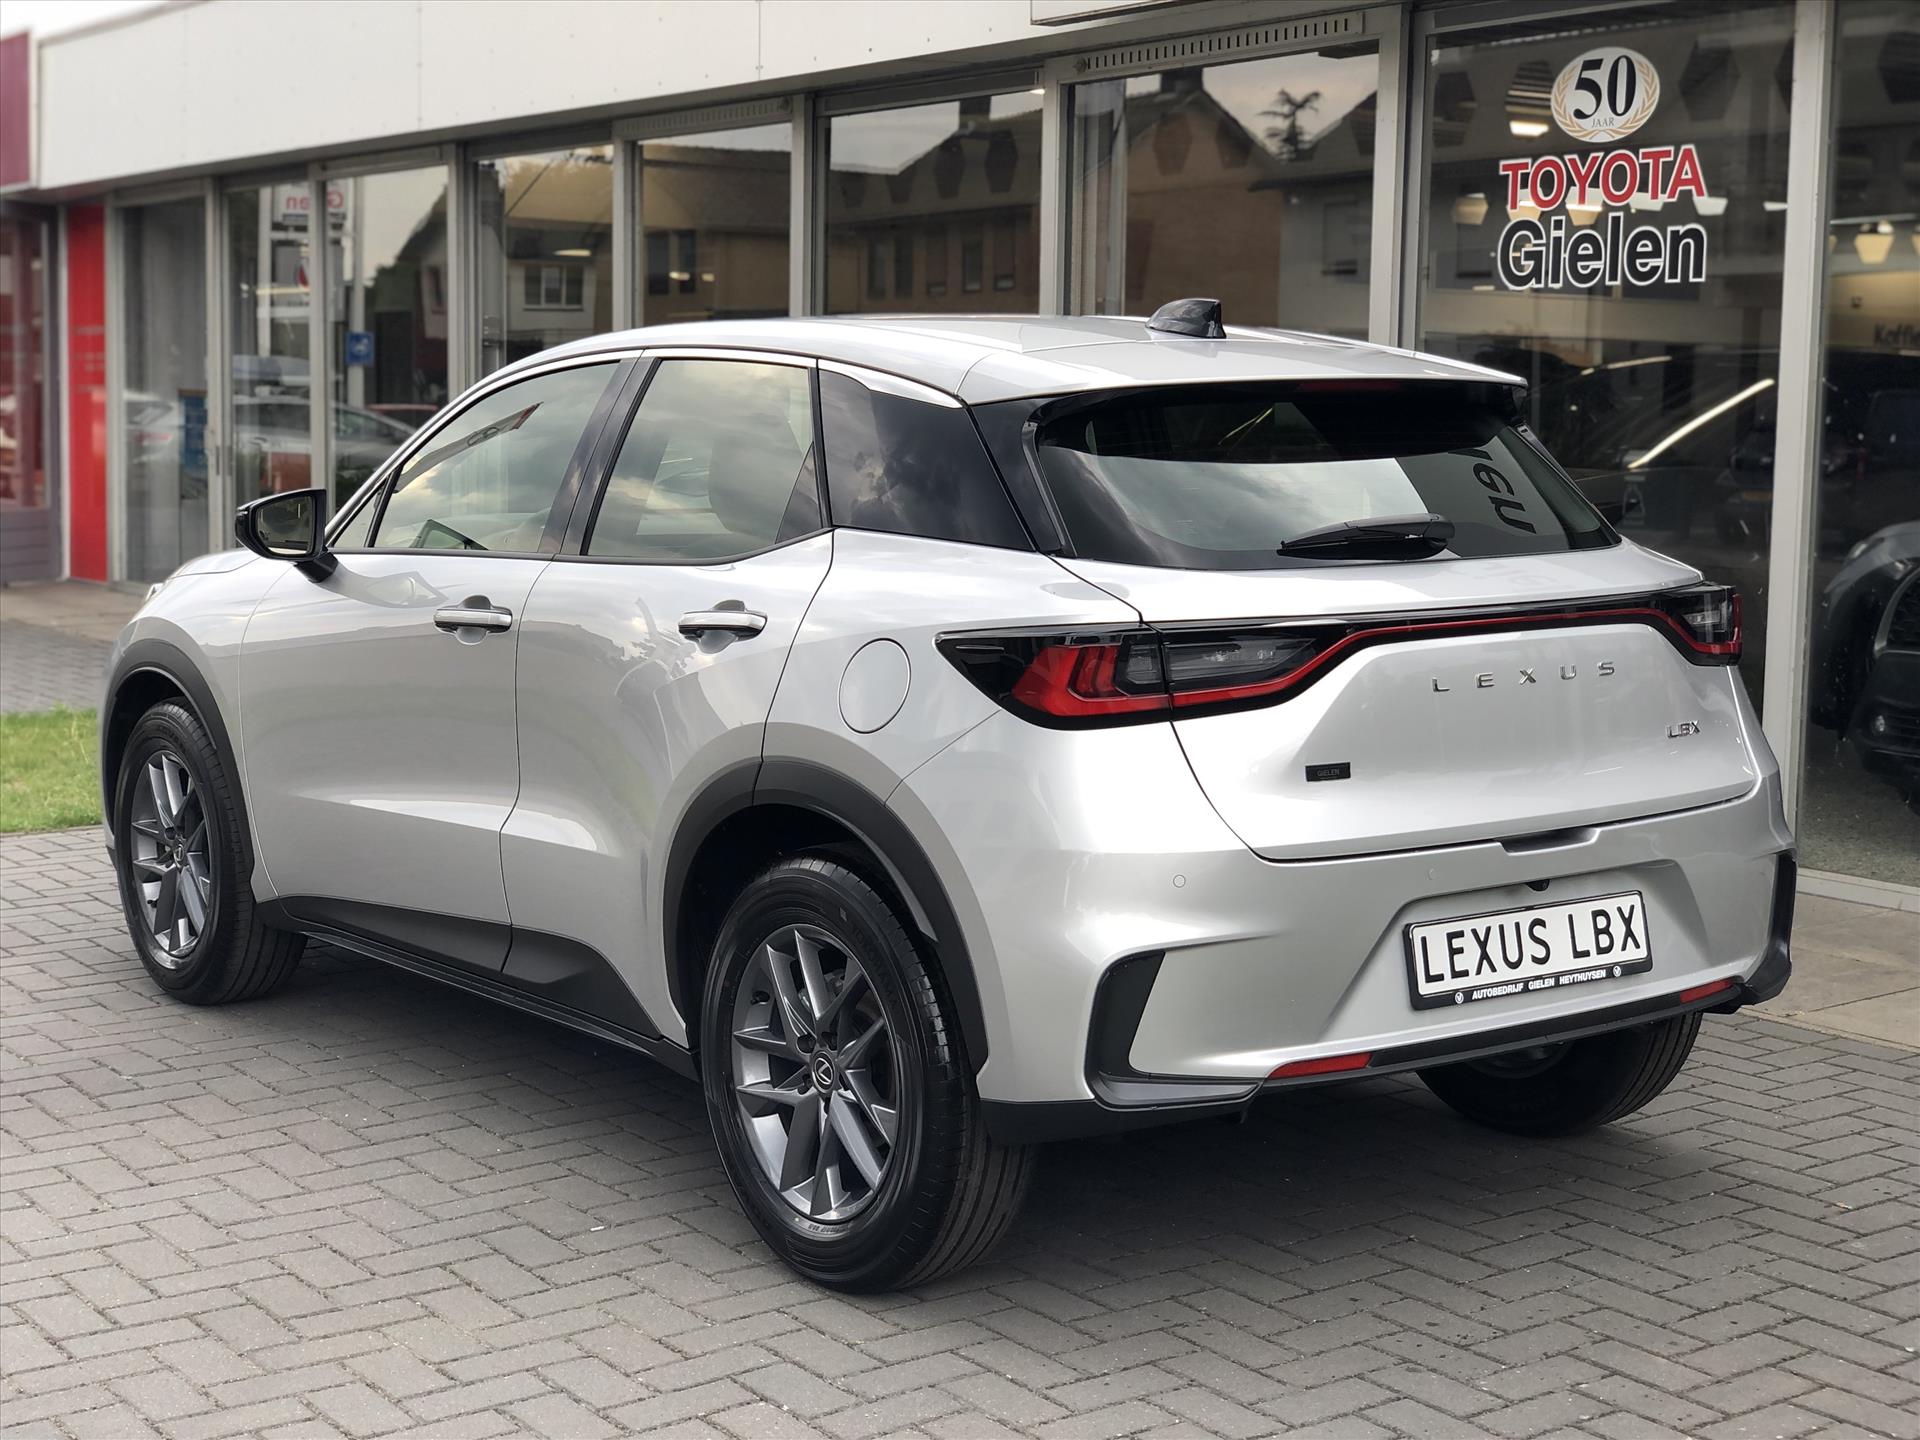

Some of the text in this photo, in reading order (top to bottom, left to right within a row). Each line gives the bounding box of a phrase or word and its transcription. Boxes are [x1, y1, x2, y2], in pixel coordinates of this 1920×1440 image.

[1573, 55, 1637, 120] 50
[1591, 117, 1615, 128] JAAR
[1500, 144, 1707, 212] TOYOTA
[1498, 212, 1707, 290] Gielen
[1431, 661, 1616, 693] LEXUS
[1665, 719, 1701, 739] LBX
[1420, 904, 1641, 984] LEXUS LBX
[1472, 969, 1607, 1000] AUTOBEDRIJF GIELEN HEYTHUYSEN
